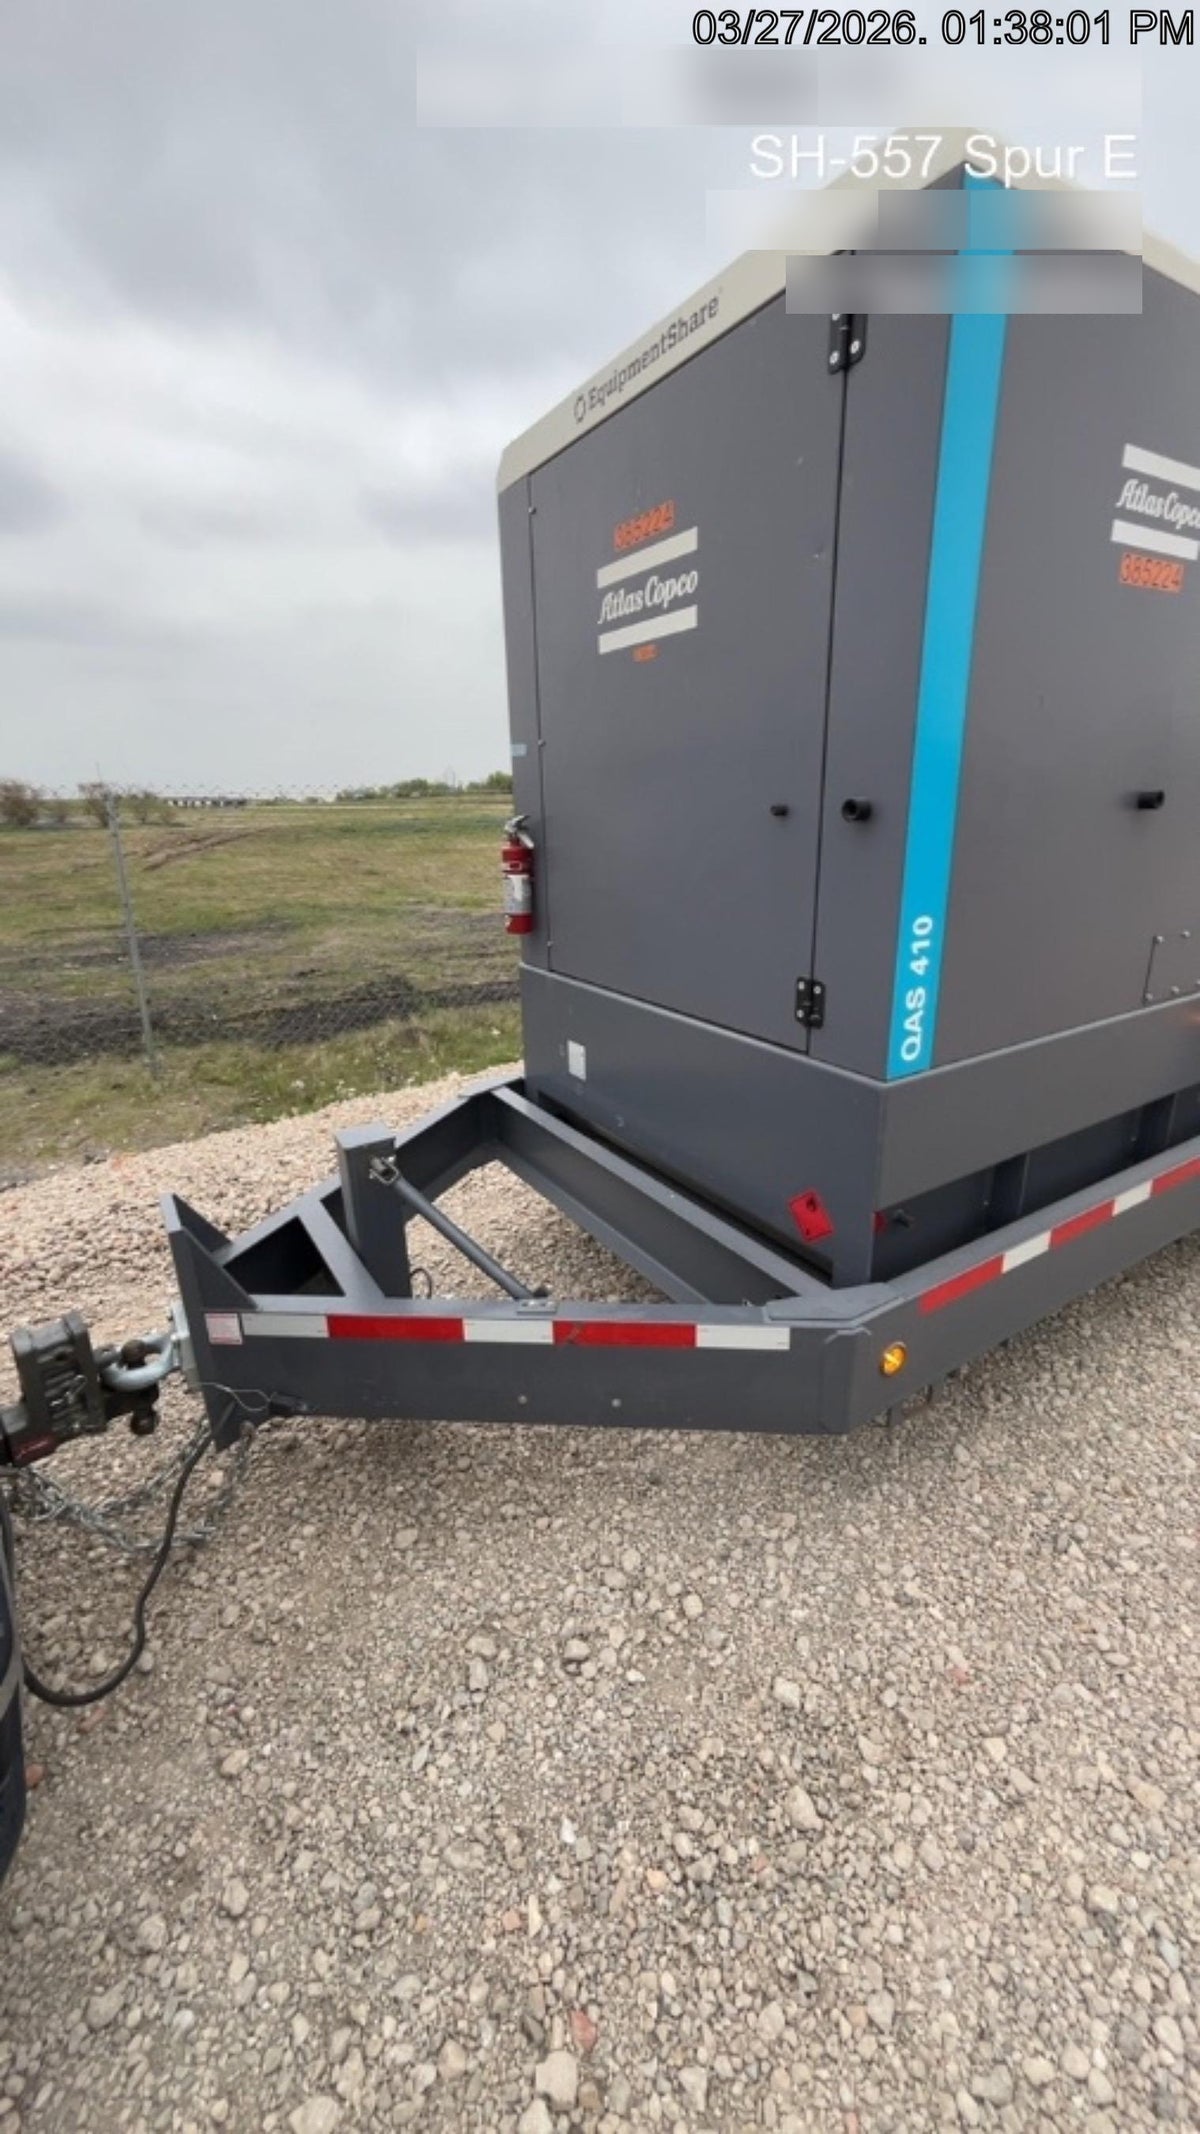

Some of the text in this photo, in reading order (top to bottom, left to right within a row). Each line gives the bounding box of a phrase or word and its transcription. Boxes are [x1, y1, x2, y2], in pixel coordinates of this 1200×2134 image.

[588, 296, 720, 411] EquipmentShare
[1115, 478, 1163, 518] Atlas
[597, 570, 698, 625] Atlas Copco
[900, 914, 934, 1062] QAS 410
